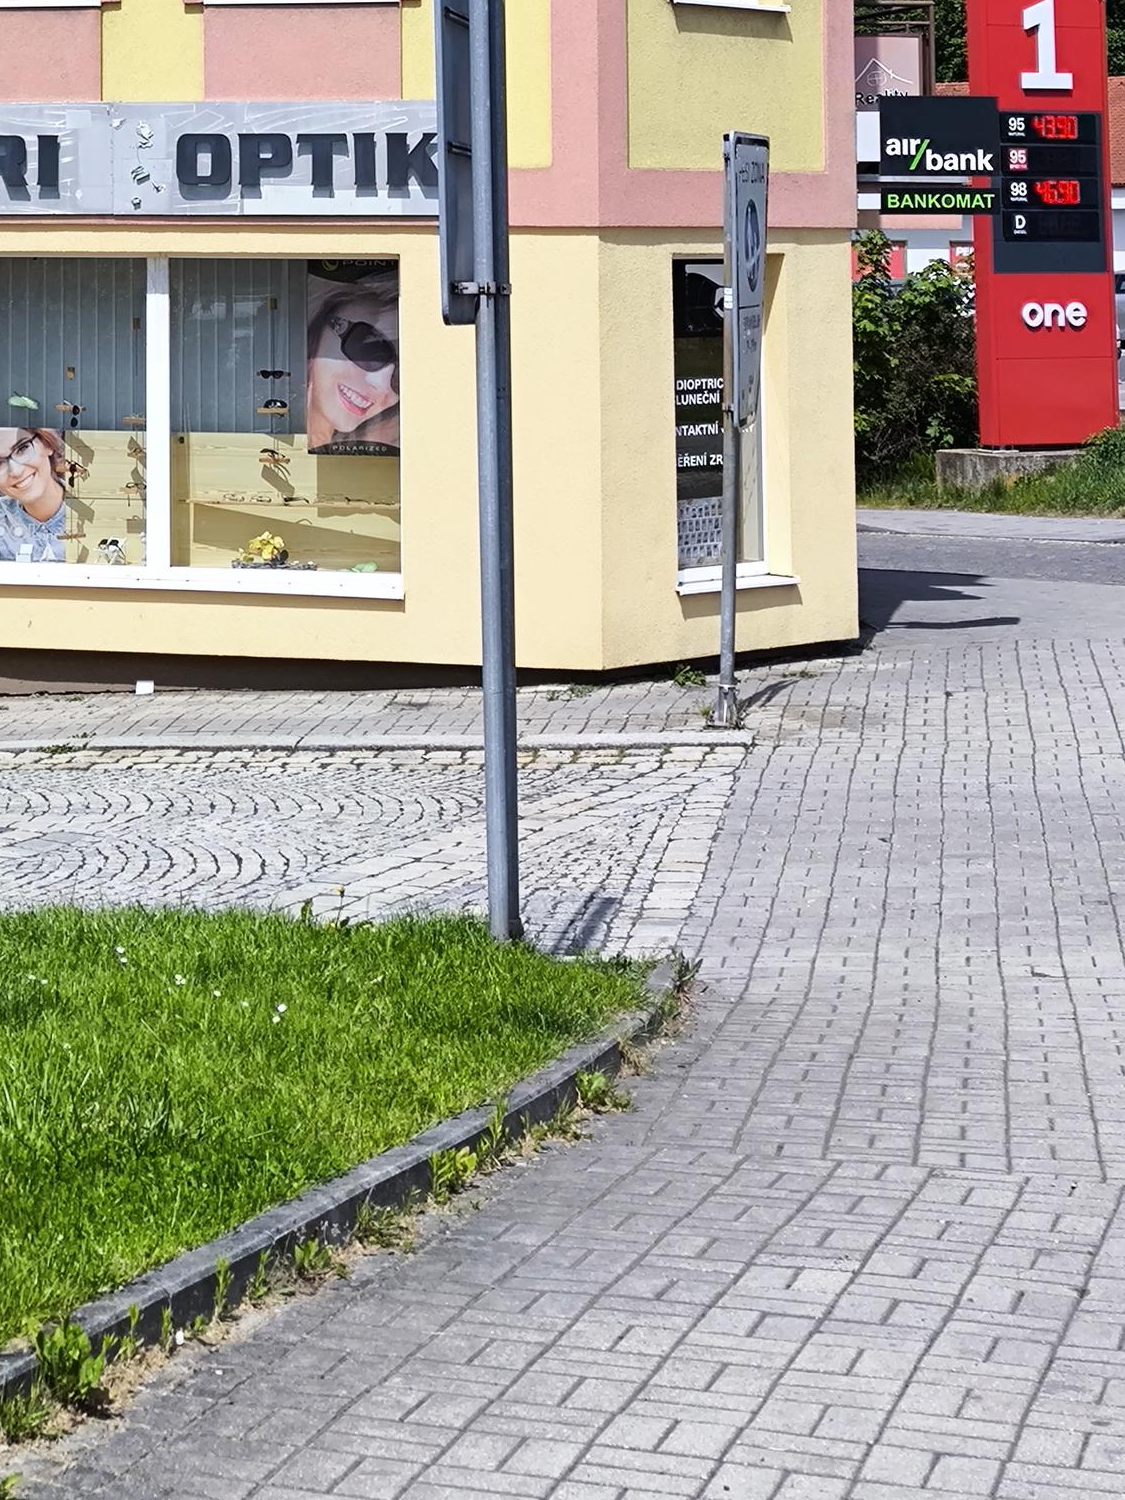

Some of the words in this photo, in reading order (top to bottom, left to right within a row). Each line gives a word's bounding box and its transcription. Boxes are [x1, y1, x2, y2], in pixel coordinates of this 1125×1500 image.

[1008, 117, 1025, 131] 95
[1009, 149, 1027, 164] 95
[1010, 182, 1027, 196] 98
[887, 194, 995, 208] BANKOMAT
[1015, 215, 1026, 229] D
[1021, 302, 1088, 327] one
